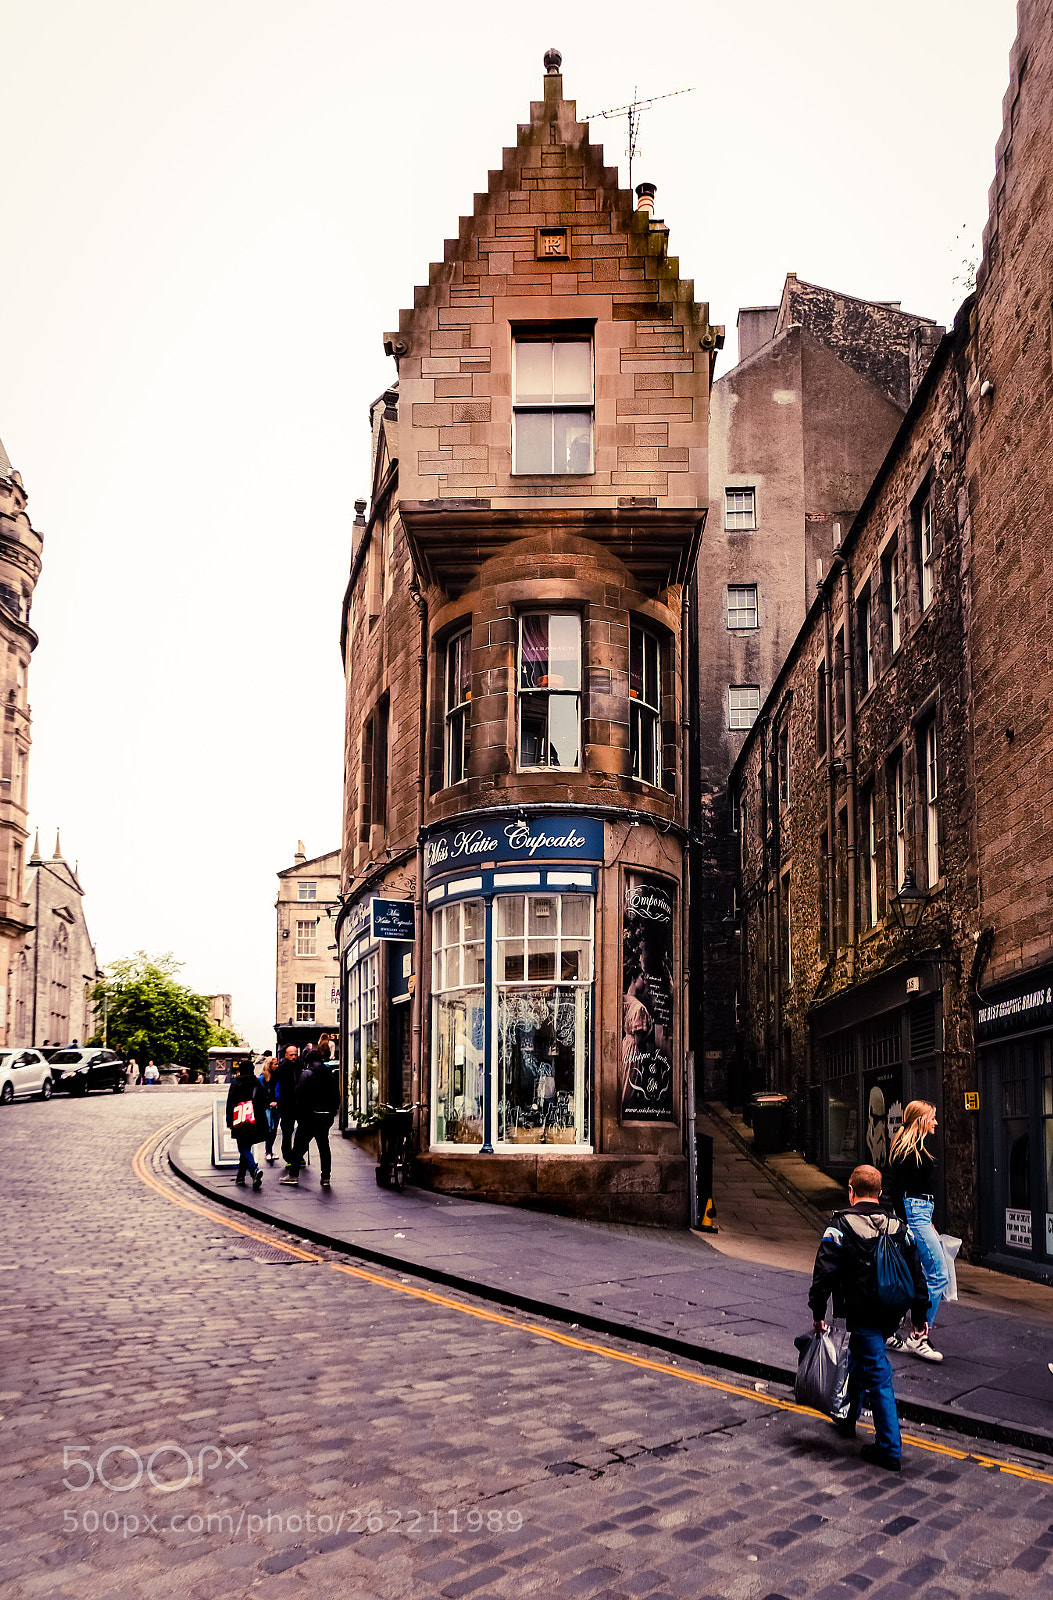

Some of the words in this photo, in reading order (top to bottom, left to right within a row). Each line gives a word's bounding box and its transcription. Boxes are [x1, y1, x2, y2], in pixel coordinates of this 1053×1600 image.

[427, 838, 449, 868] Miss
[450, 829, 499, 858] Katie
[503, 823, 586, 857] Cupcake
[331, 988, 340, 997] BA
[987, 1004, 999, 1021] BEST
[1021, 989, 1045, 1011] BRANDS
[1046, 987, 1052, 1004] &
